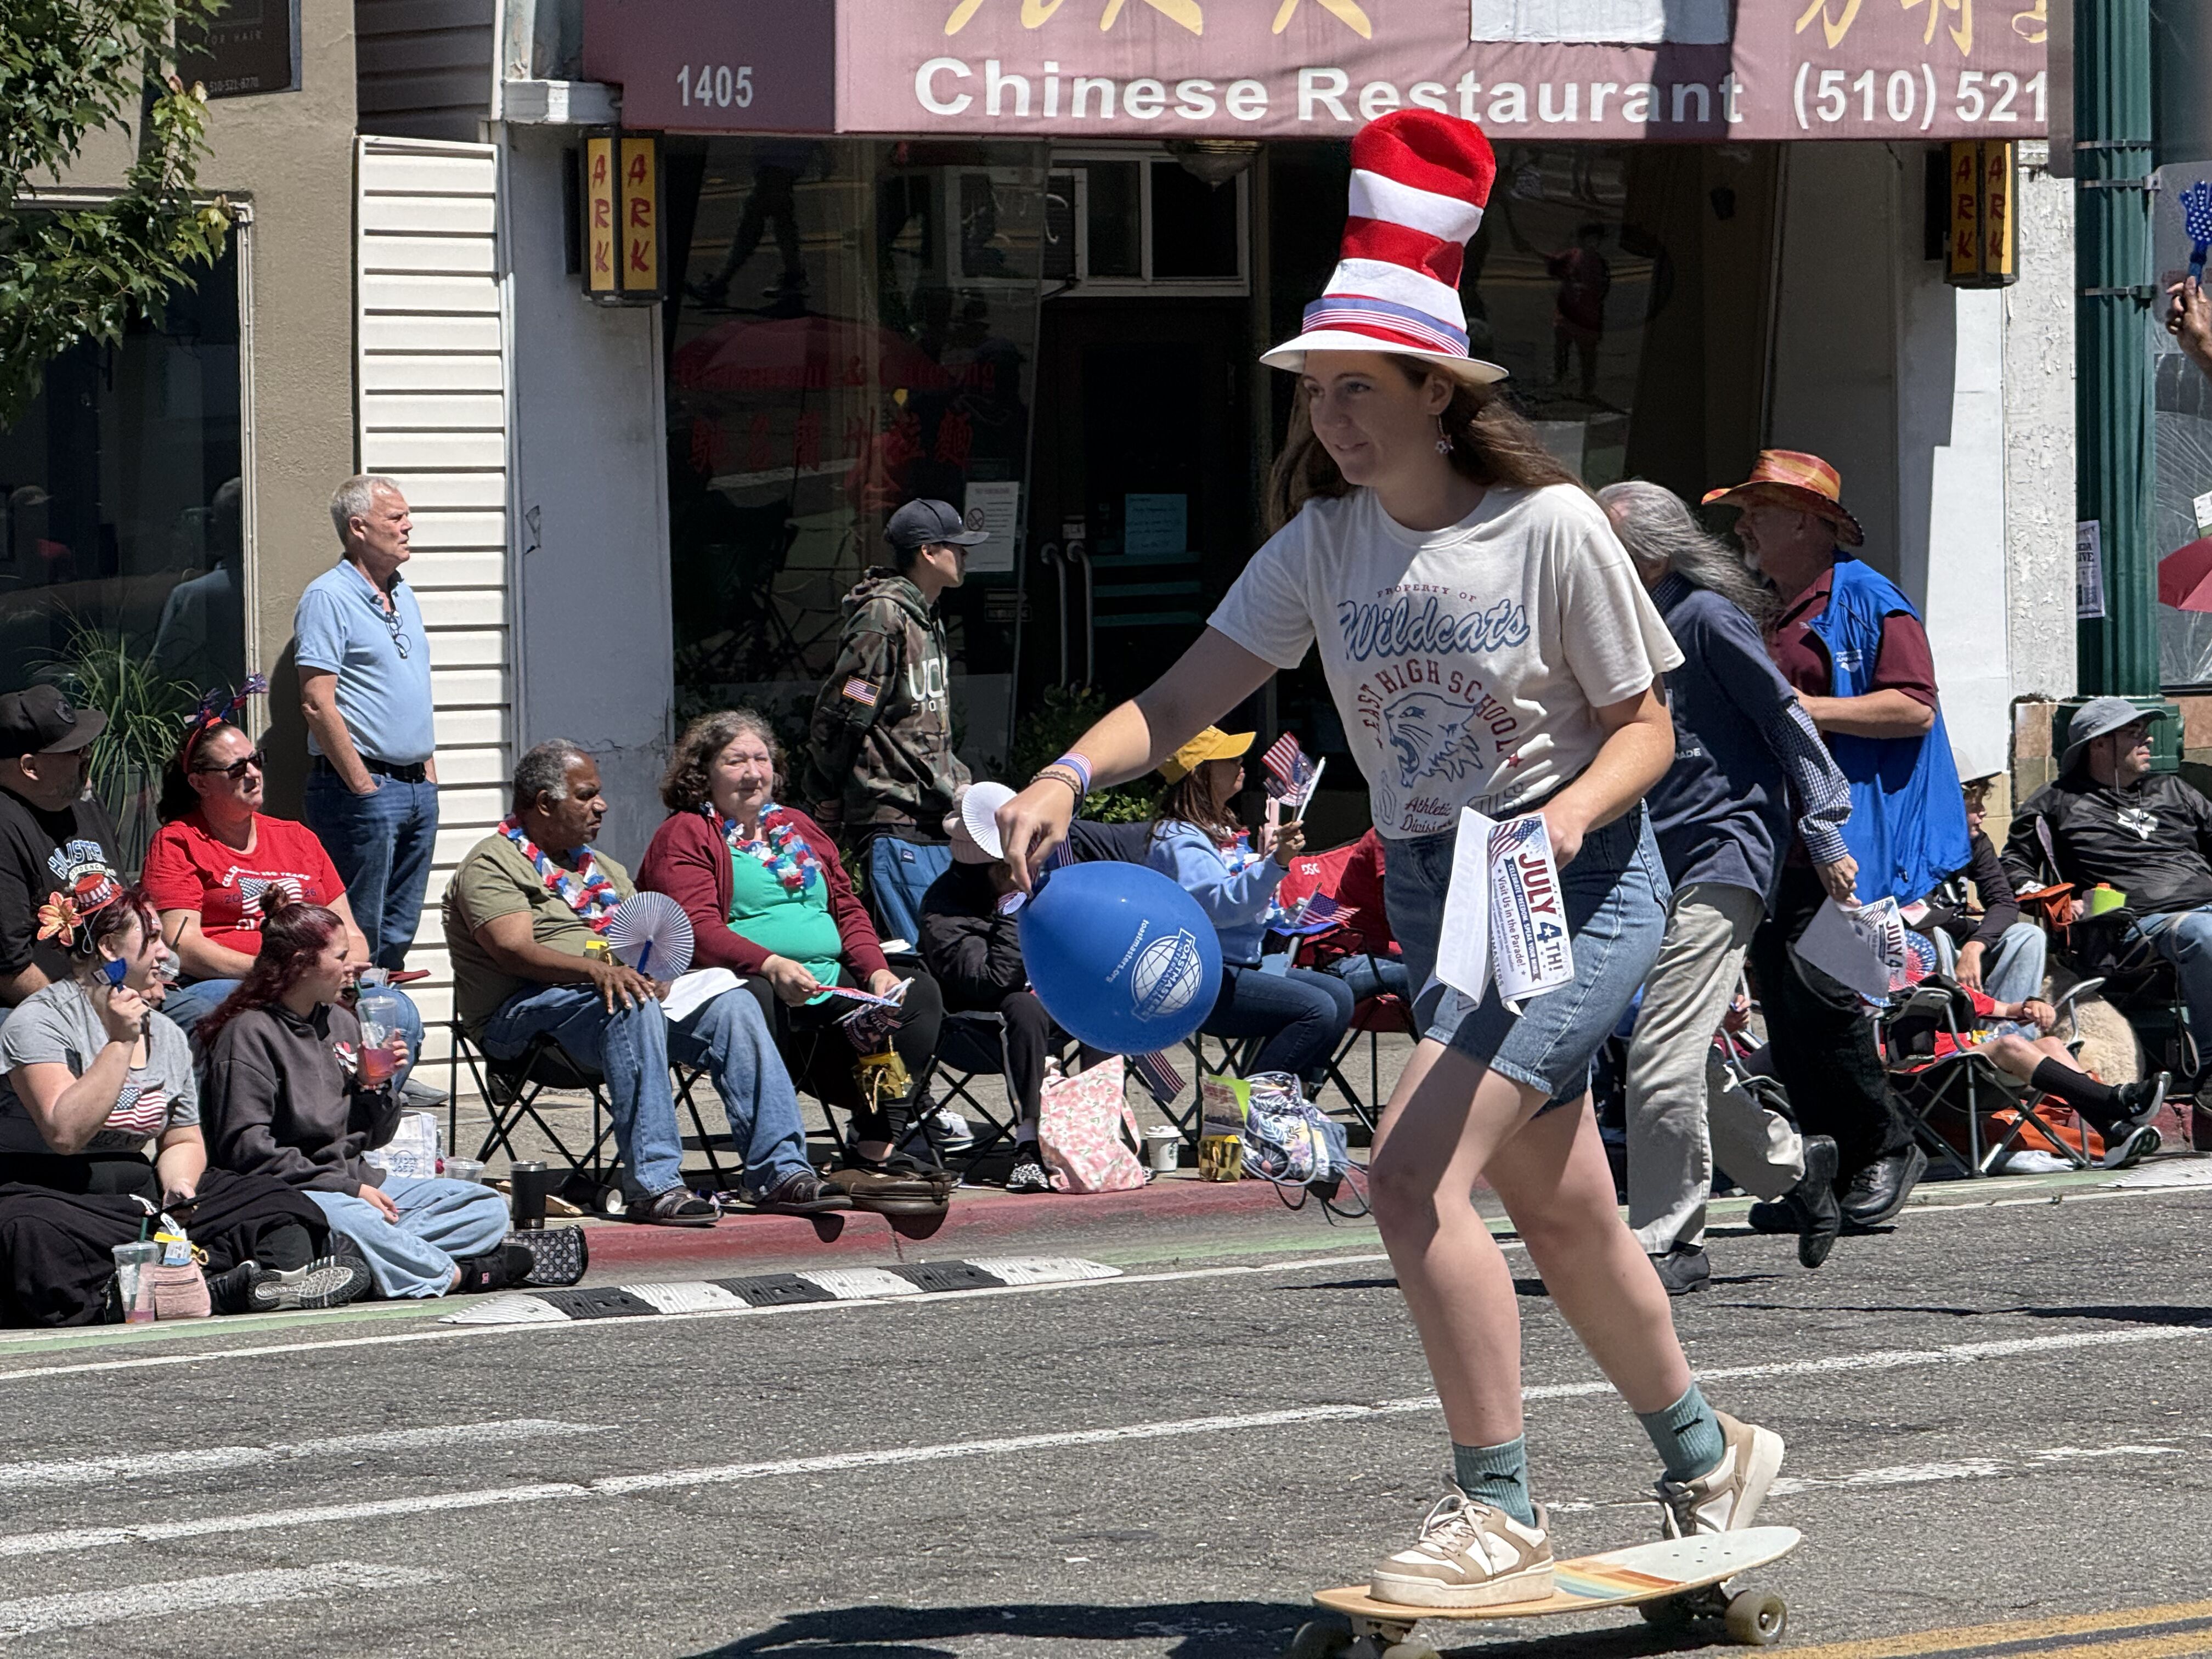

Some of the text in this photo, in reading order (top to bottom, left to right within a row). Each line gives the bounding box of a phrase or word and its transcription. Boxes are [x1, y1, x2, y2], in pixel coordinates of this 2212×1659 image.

[676, 65, 754, 109] 1405
[915, 57, 2047, 130] Chinese Restaurant (510) 521
[592, 154, 611, 273] ARK
[627, 153, 651, 273] ARK
[1955, 155, 1975, 259] ARK
[1987, 155, 2005, 259] ARK
[1338, 596, 1531, 661] Wildcats
[1377, 584, 1477, 602] PROPERTY OF
[1358, 659, 1520, 753] EAST HIGH SCHOOL
[1405, 797, 1453, 816] Athletic
[1508, 864, 1522, 894] CELEBRATE
[1523, 923, 1533, 941] SPEAK
[1528, 942, 1536, 958] YOUR
[1518, 852, 1557, 915] JULY
[1106, 919, 1150, 983] toastmasters.org
[1498, 876, 1526, 967] Visit Us in the Parade!
[1886, 920, 1903, 956] JULY
[1140, 938, 1193, 1016] TOASTMASTERS
